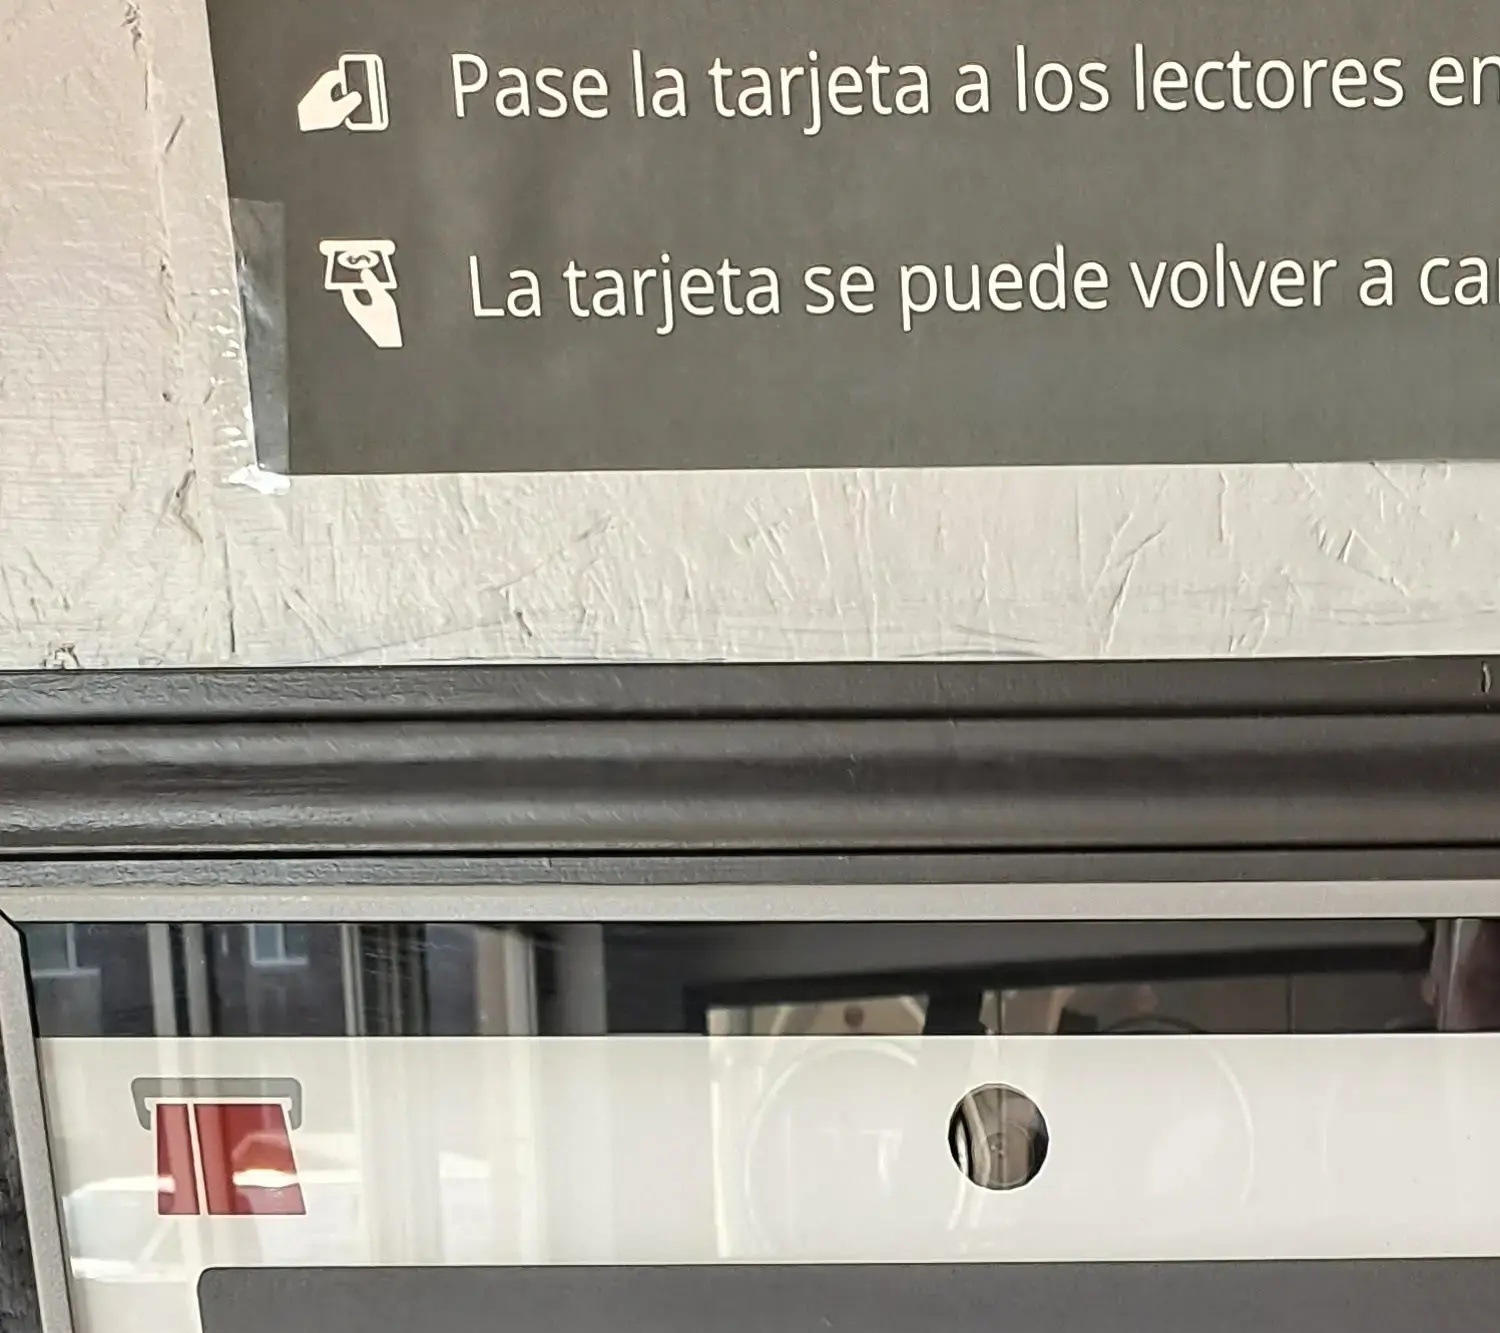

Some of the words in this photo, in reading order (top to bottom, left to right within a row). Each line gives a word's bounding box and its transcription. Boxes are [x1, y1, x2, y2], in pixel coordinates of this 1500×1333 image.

[452, 54, 608, 118] Pase
[633, 50, 686, 117] la
[708, 51, 930, 134] tarjeta
[956, 65, 989, 112] a
[1016, 45, 1109, 112] los
[1135, 44, 1404, 110] lectores
[469, 255, 541, 317] La
[563, 253, 780, 334] tarjeta
[804, 265, 875, 314] se
[900, 244, 1109, 331] puede
[1130, 242, 1336, 308] volver
[1359, 258, 1393, 306] a
